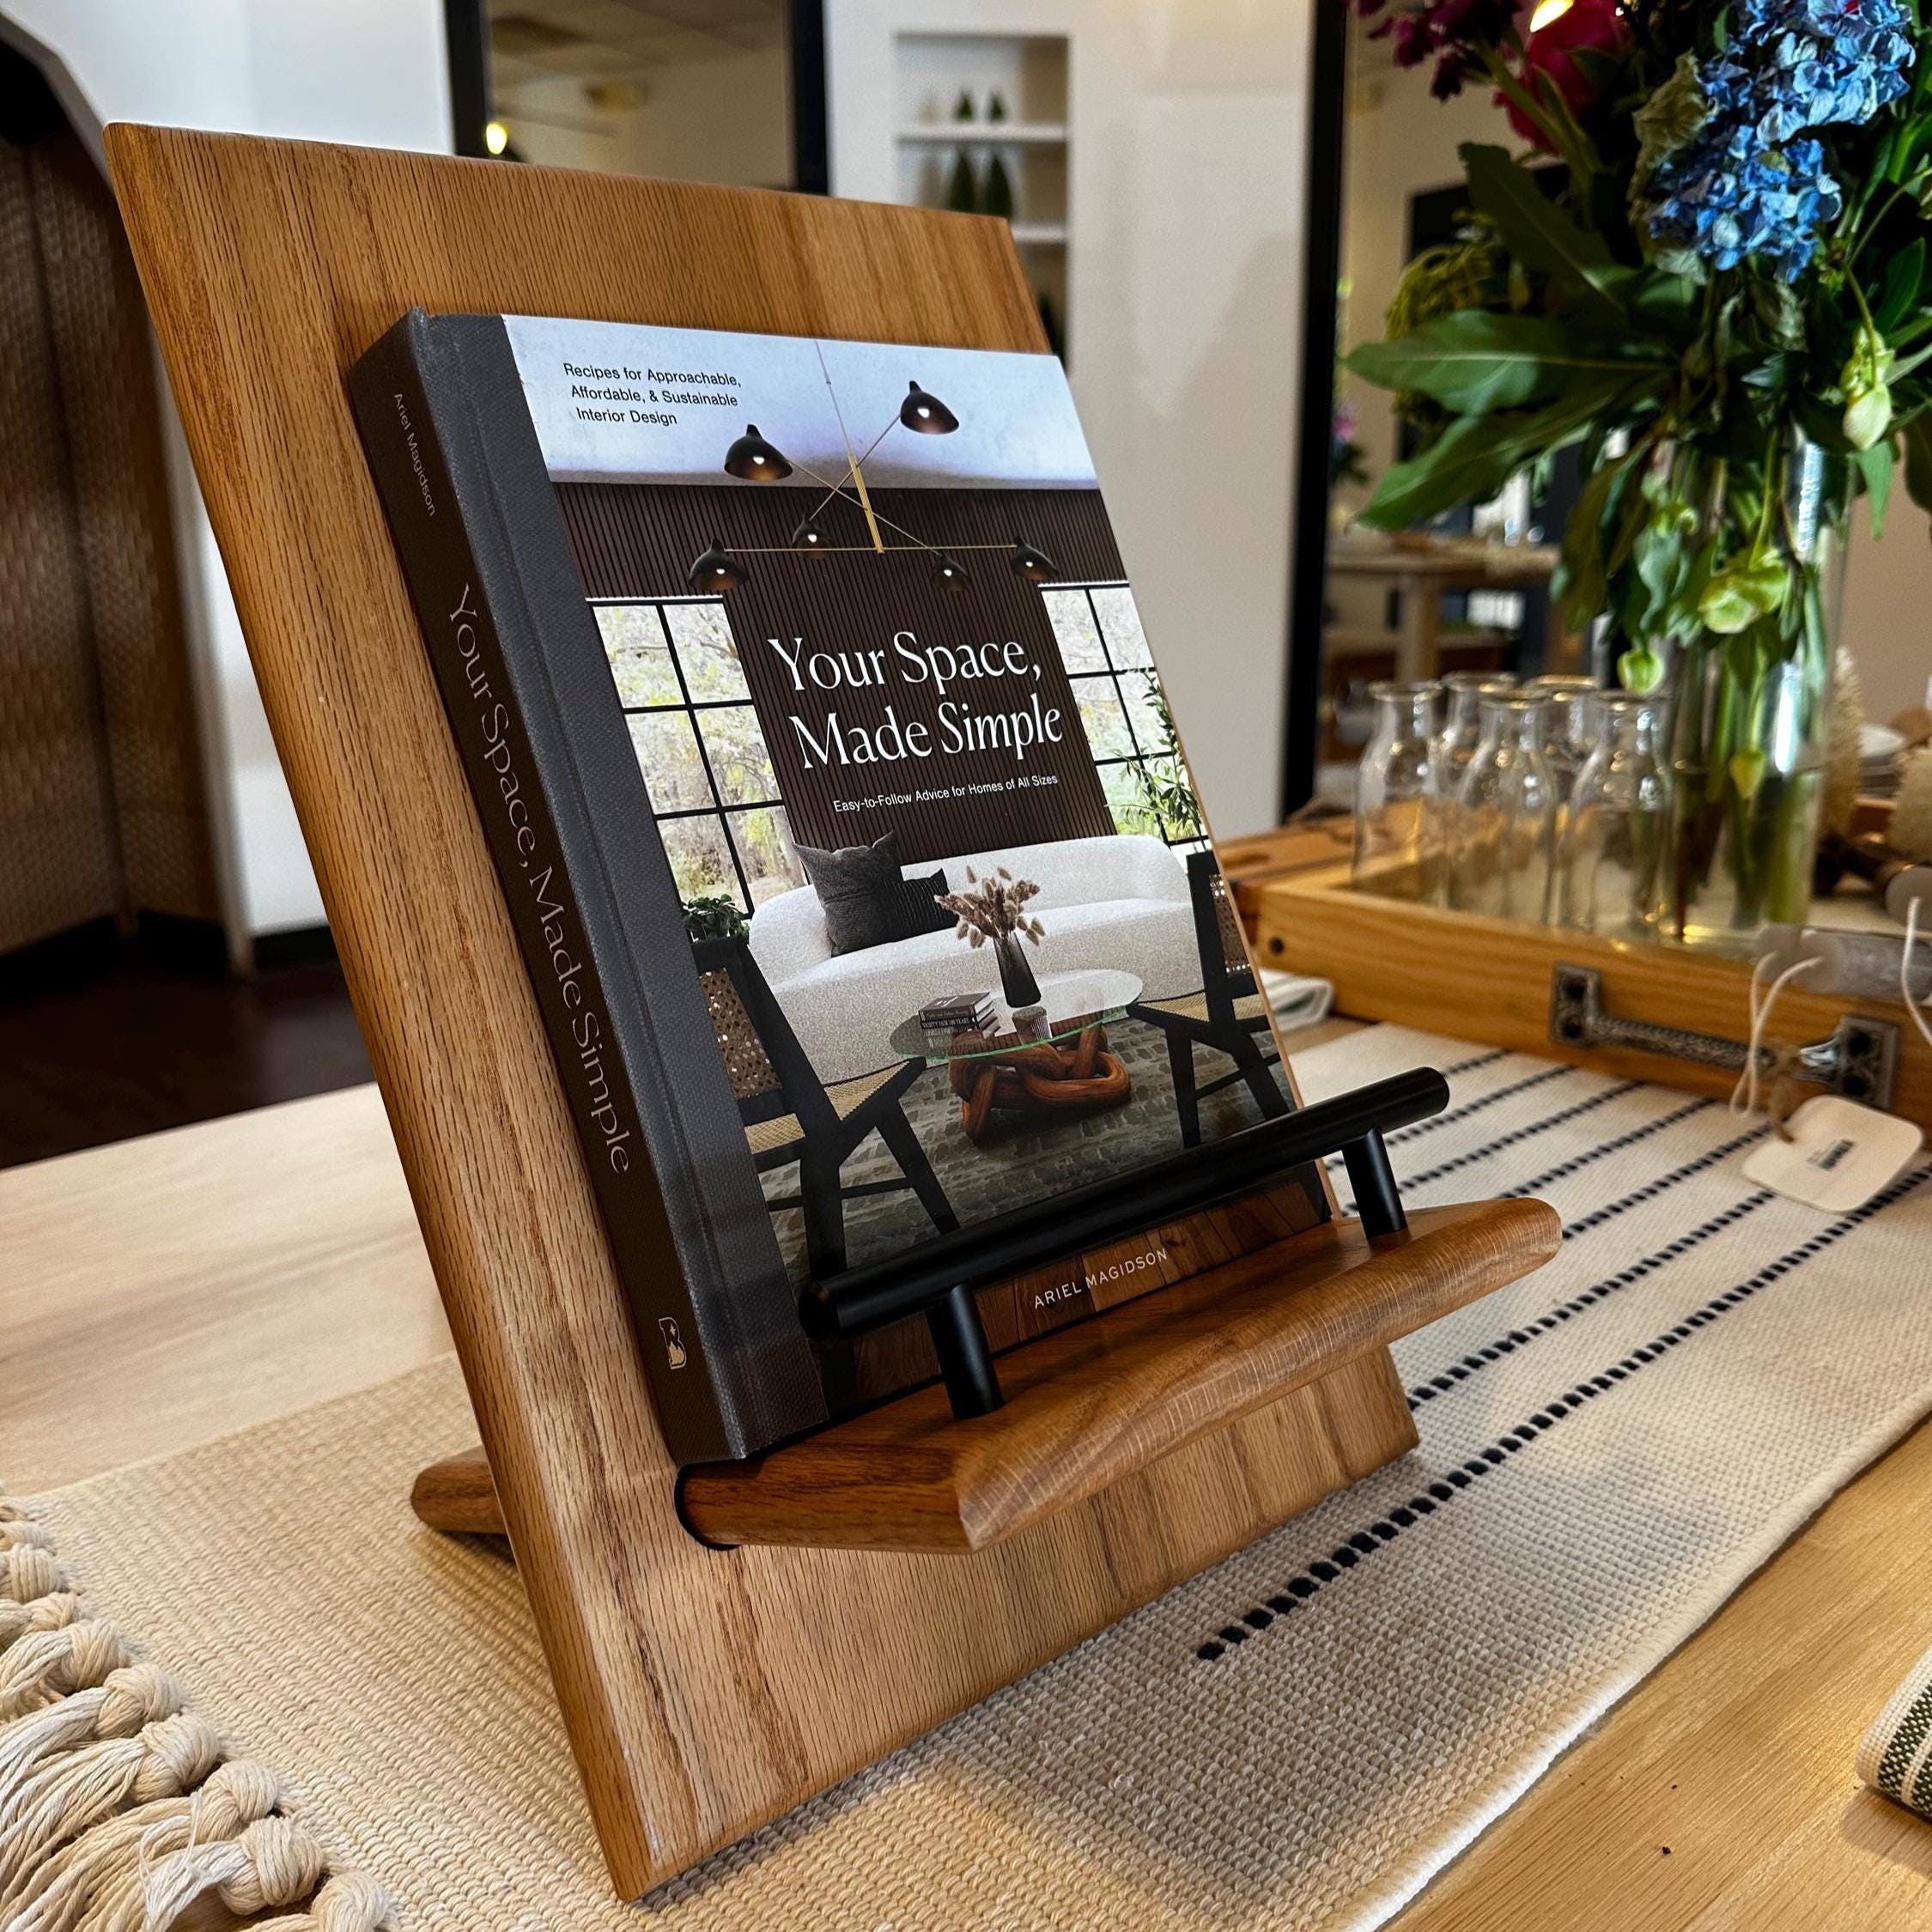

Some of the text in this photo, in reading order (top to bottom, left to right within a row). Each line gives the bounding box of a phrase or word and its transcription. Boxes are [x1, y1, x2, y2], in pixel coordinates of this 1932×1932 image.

[563, 362, 742, 387] Recipes for Approachable,
[571, 385, 738, 406] Affordable, & Sustainable
[576, 407, 677, 427] Interior Design
[394, 393, 436, 516] Ariel Magidson
[767, 631, 1042, 695] Your Space,
[789, 692, 1063, 769] Made Simple
[833, 774, 1059, 812] Easy-to-Follow Advice for Homes of All Sizes
[450, 582, 631, 1175] Your Space, Made Simple
[1035, 1248, 1168, 1309] ARIEL MAGIDSON
